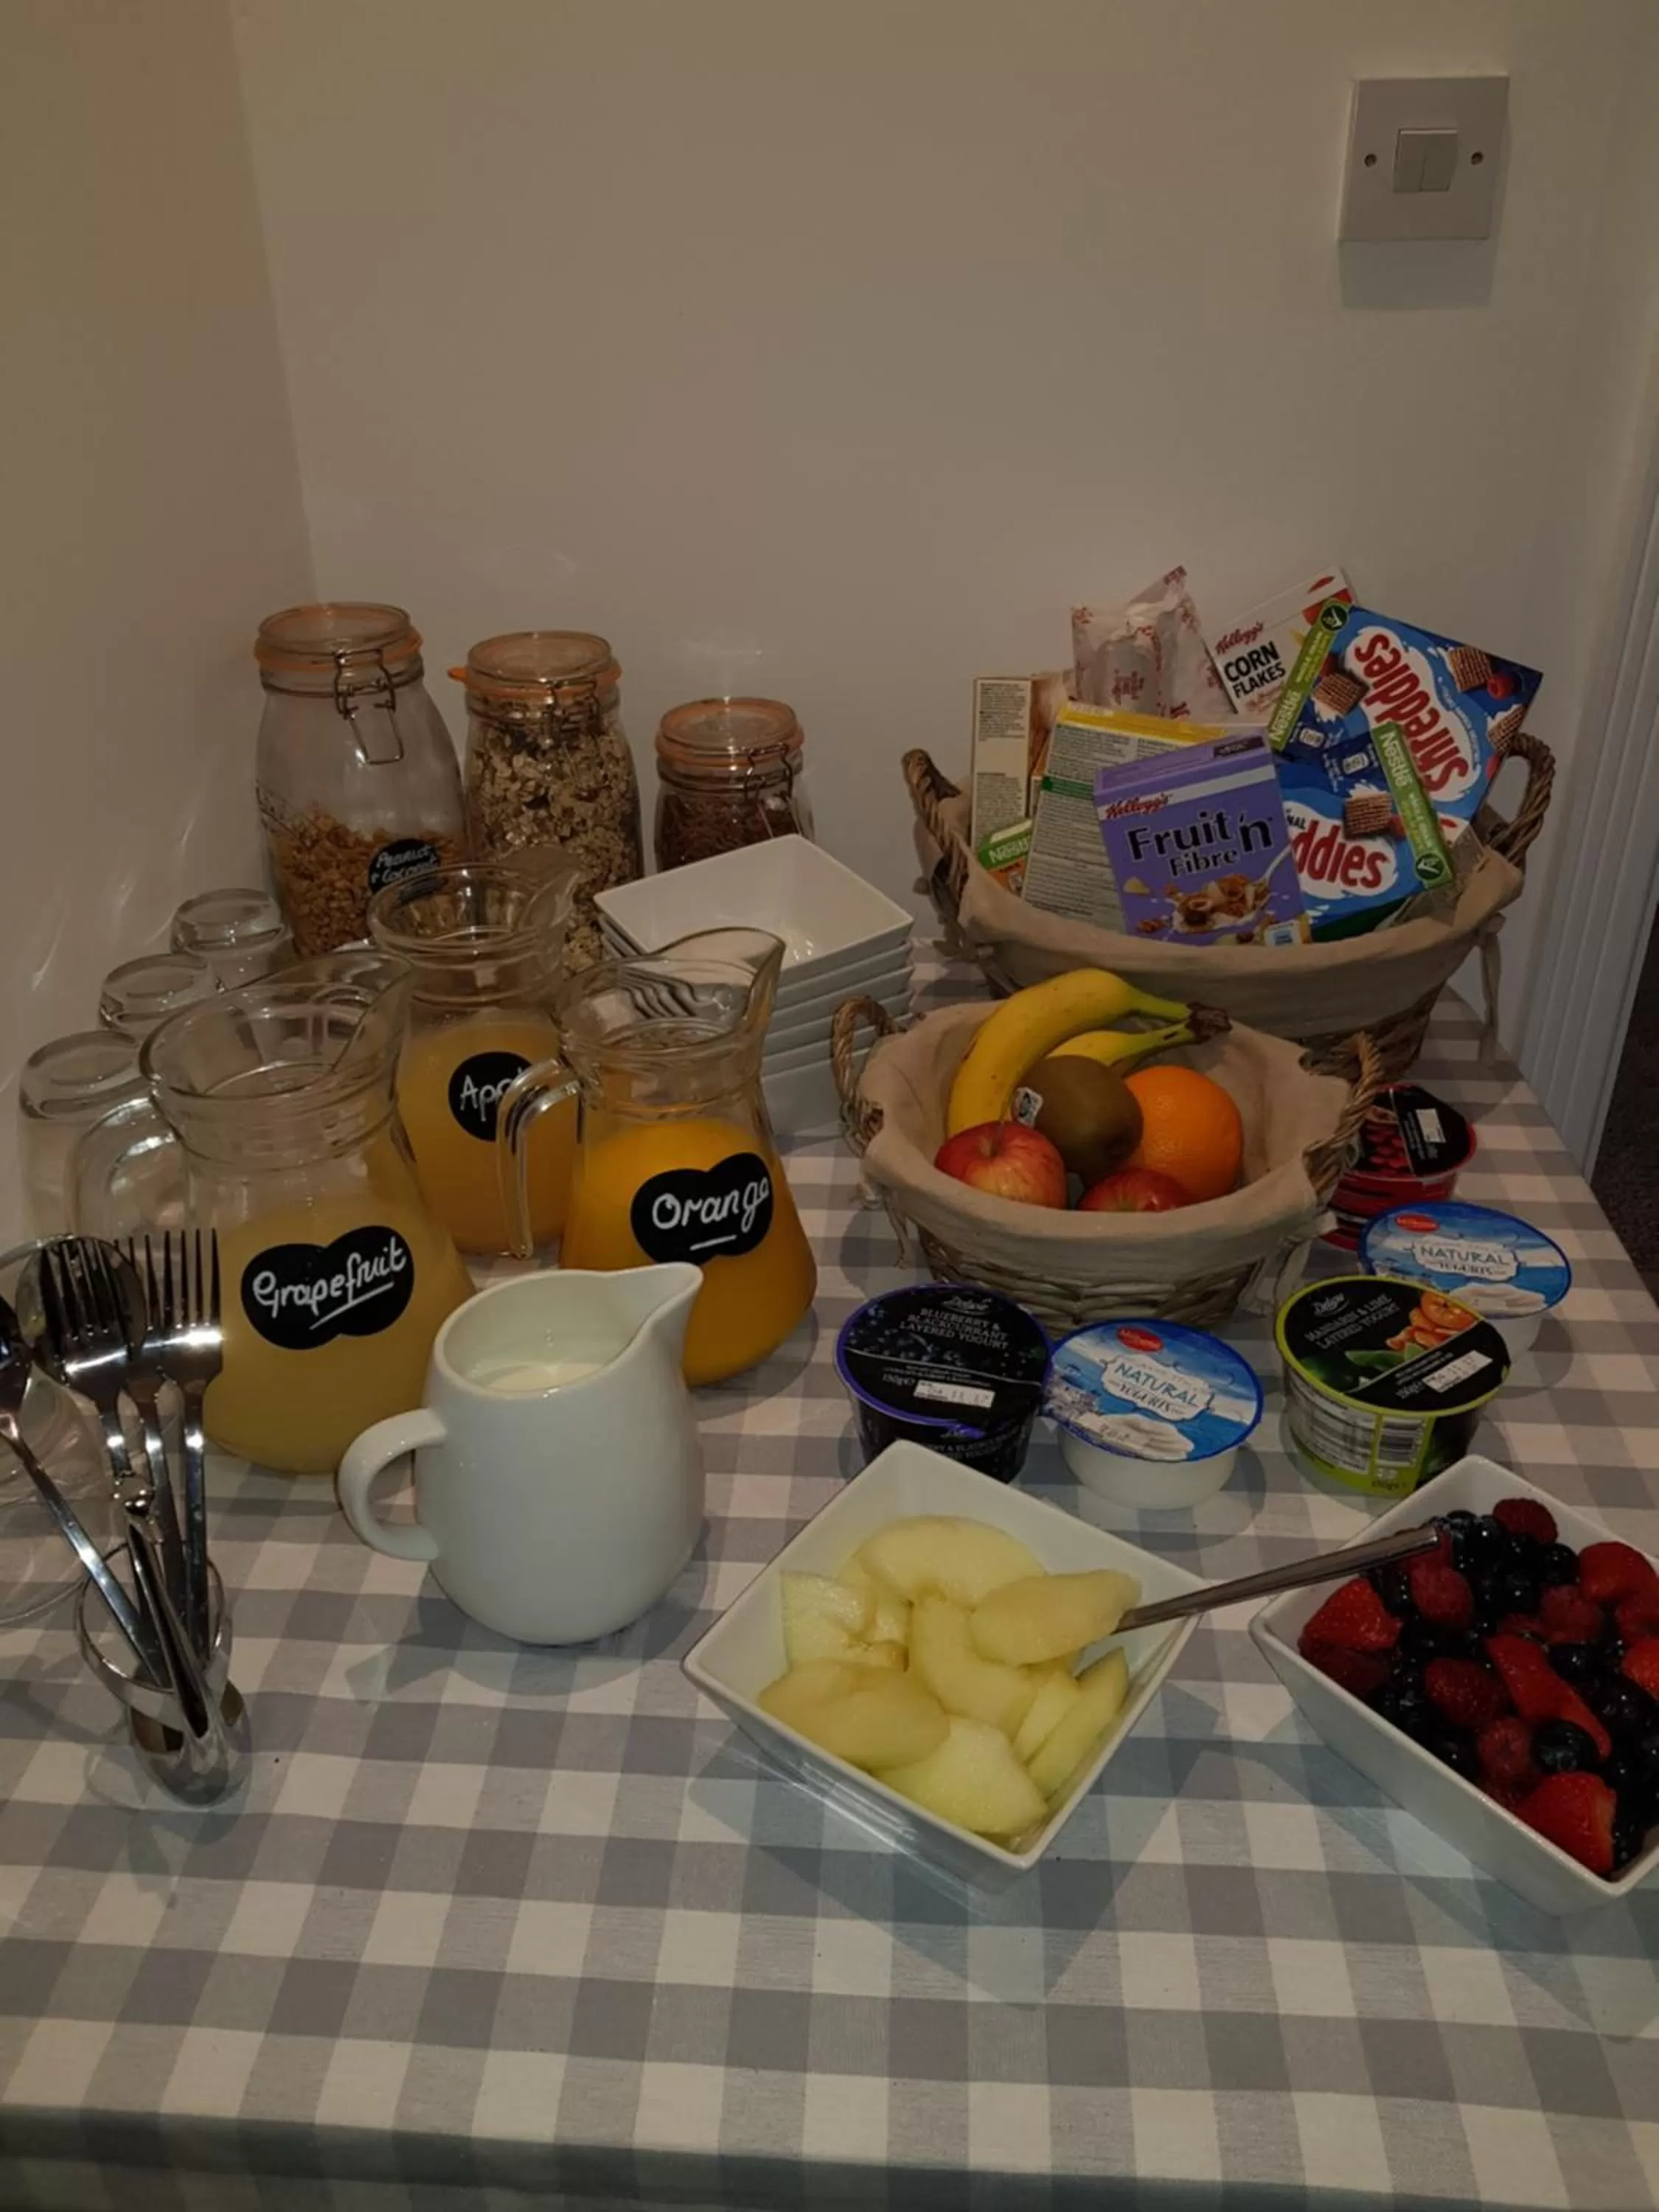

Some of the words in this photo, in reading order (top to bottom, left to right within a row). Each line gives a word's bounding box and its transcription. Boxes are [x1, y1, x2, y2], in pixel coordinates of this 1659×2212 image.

[1225, 640, 1280, 682] CORN
[1233, 661, 1286, 699] FLAKES
[1127, 811, 1231, 860] Fruit
[1169, 849, 1238, 877] Fibre
[459, 1066, 524, 1124] App
[652, 1176, 770, 1234] Orange
[252, 1235, 407, 1319] Grapefruit
[1420, 1246, 1511, 1267] NATURAL
[1114, 1363, 1199, 1407] NATURAL
